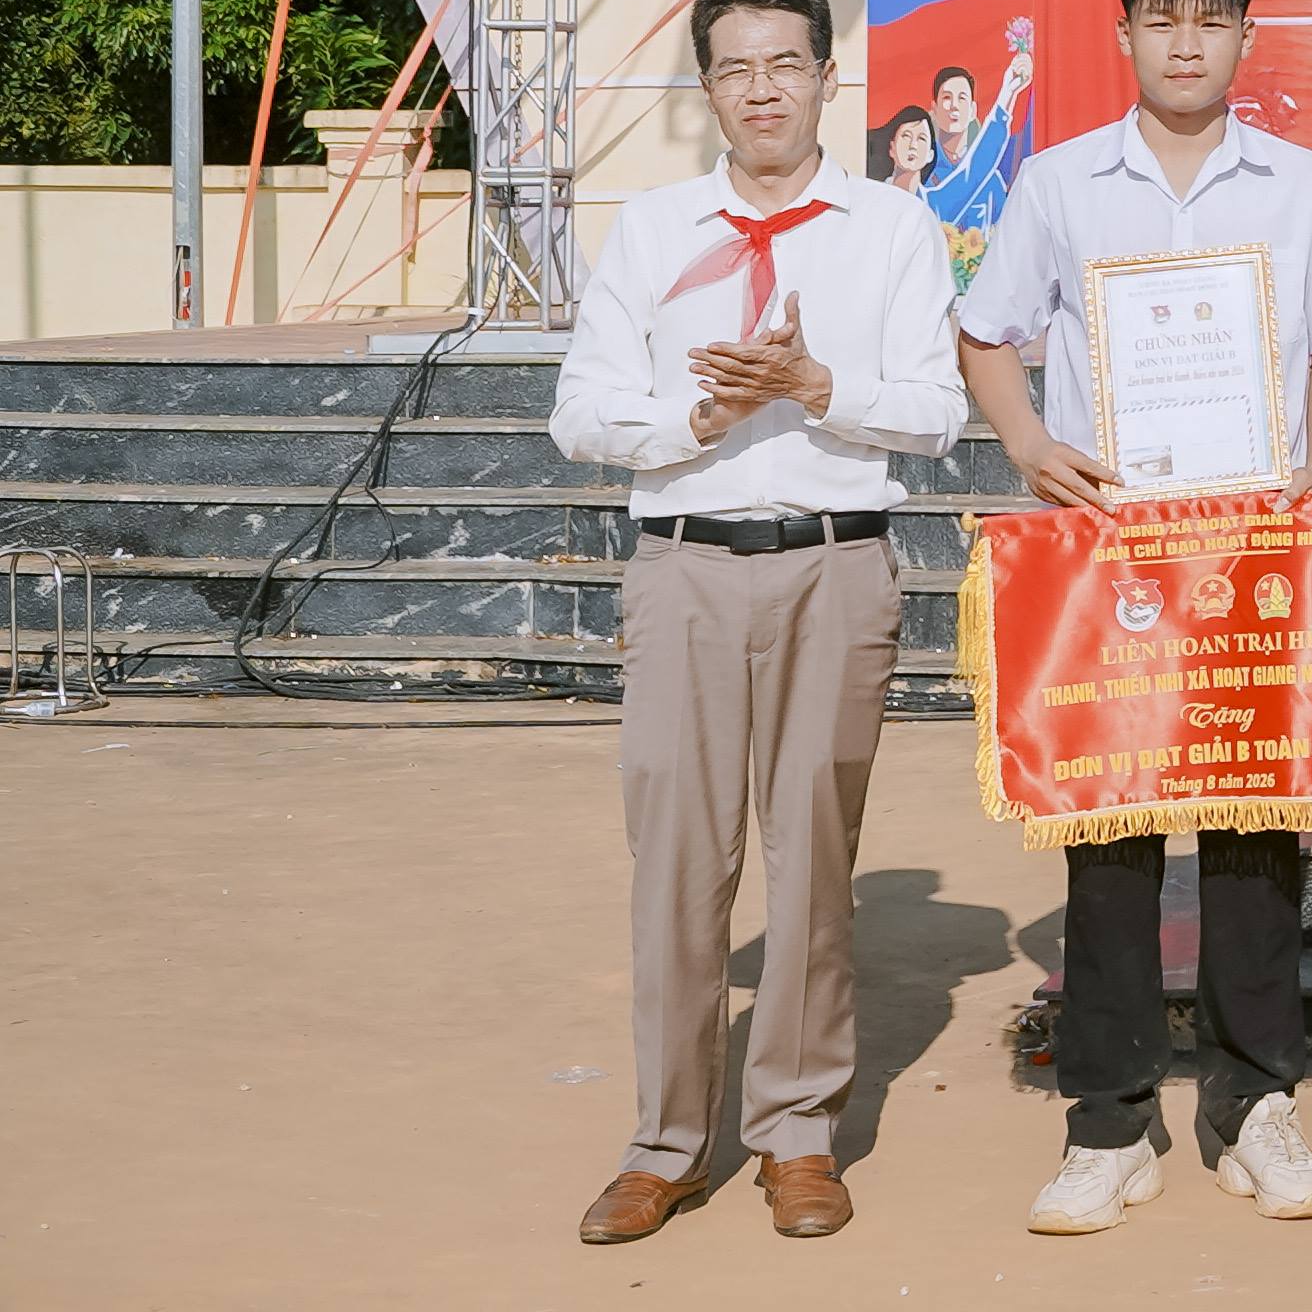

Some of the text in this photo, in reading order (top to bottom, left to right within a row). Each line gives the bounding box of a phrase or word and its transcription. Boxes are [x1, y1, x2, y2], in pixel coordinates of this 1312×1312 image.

[1100, 639, 1156, 665] LIÊN
[1164, 635, 1229, 659] HOAN
[1234, 631, 1282, 656] TRẠI
[1179, 702, 1255, 733] Tặng
[1053, 754, 1103, 781] ĐƠN
[1109, 752, 1132, 777] VỊ
[1138, 746, 1182, 772] ĐẠT
[1188, 736, 1232, 765] GIẢI
[1237, 740, 1250, 762] B
[1254, 734, 1310, 760] TOÀN
[1161, 772, 1275, 796] Tháng 8 năm 2026
